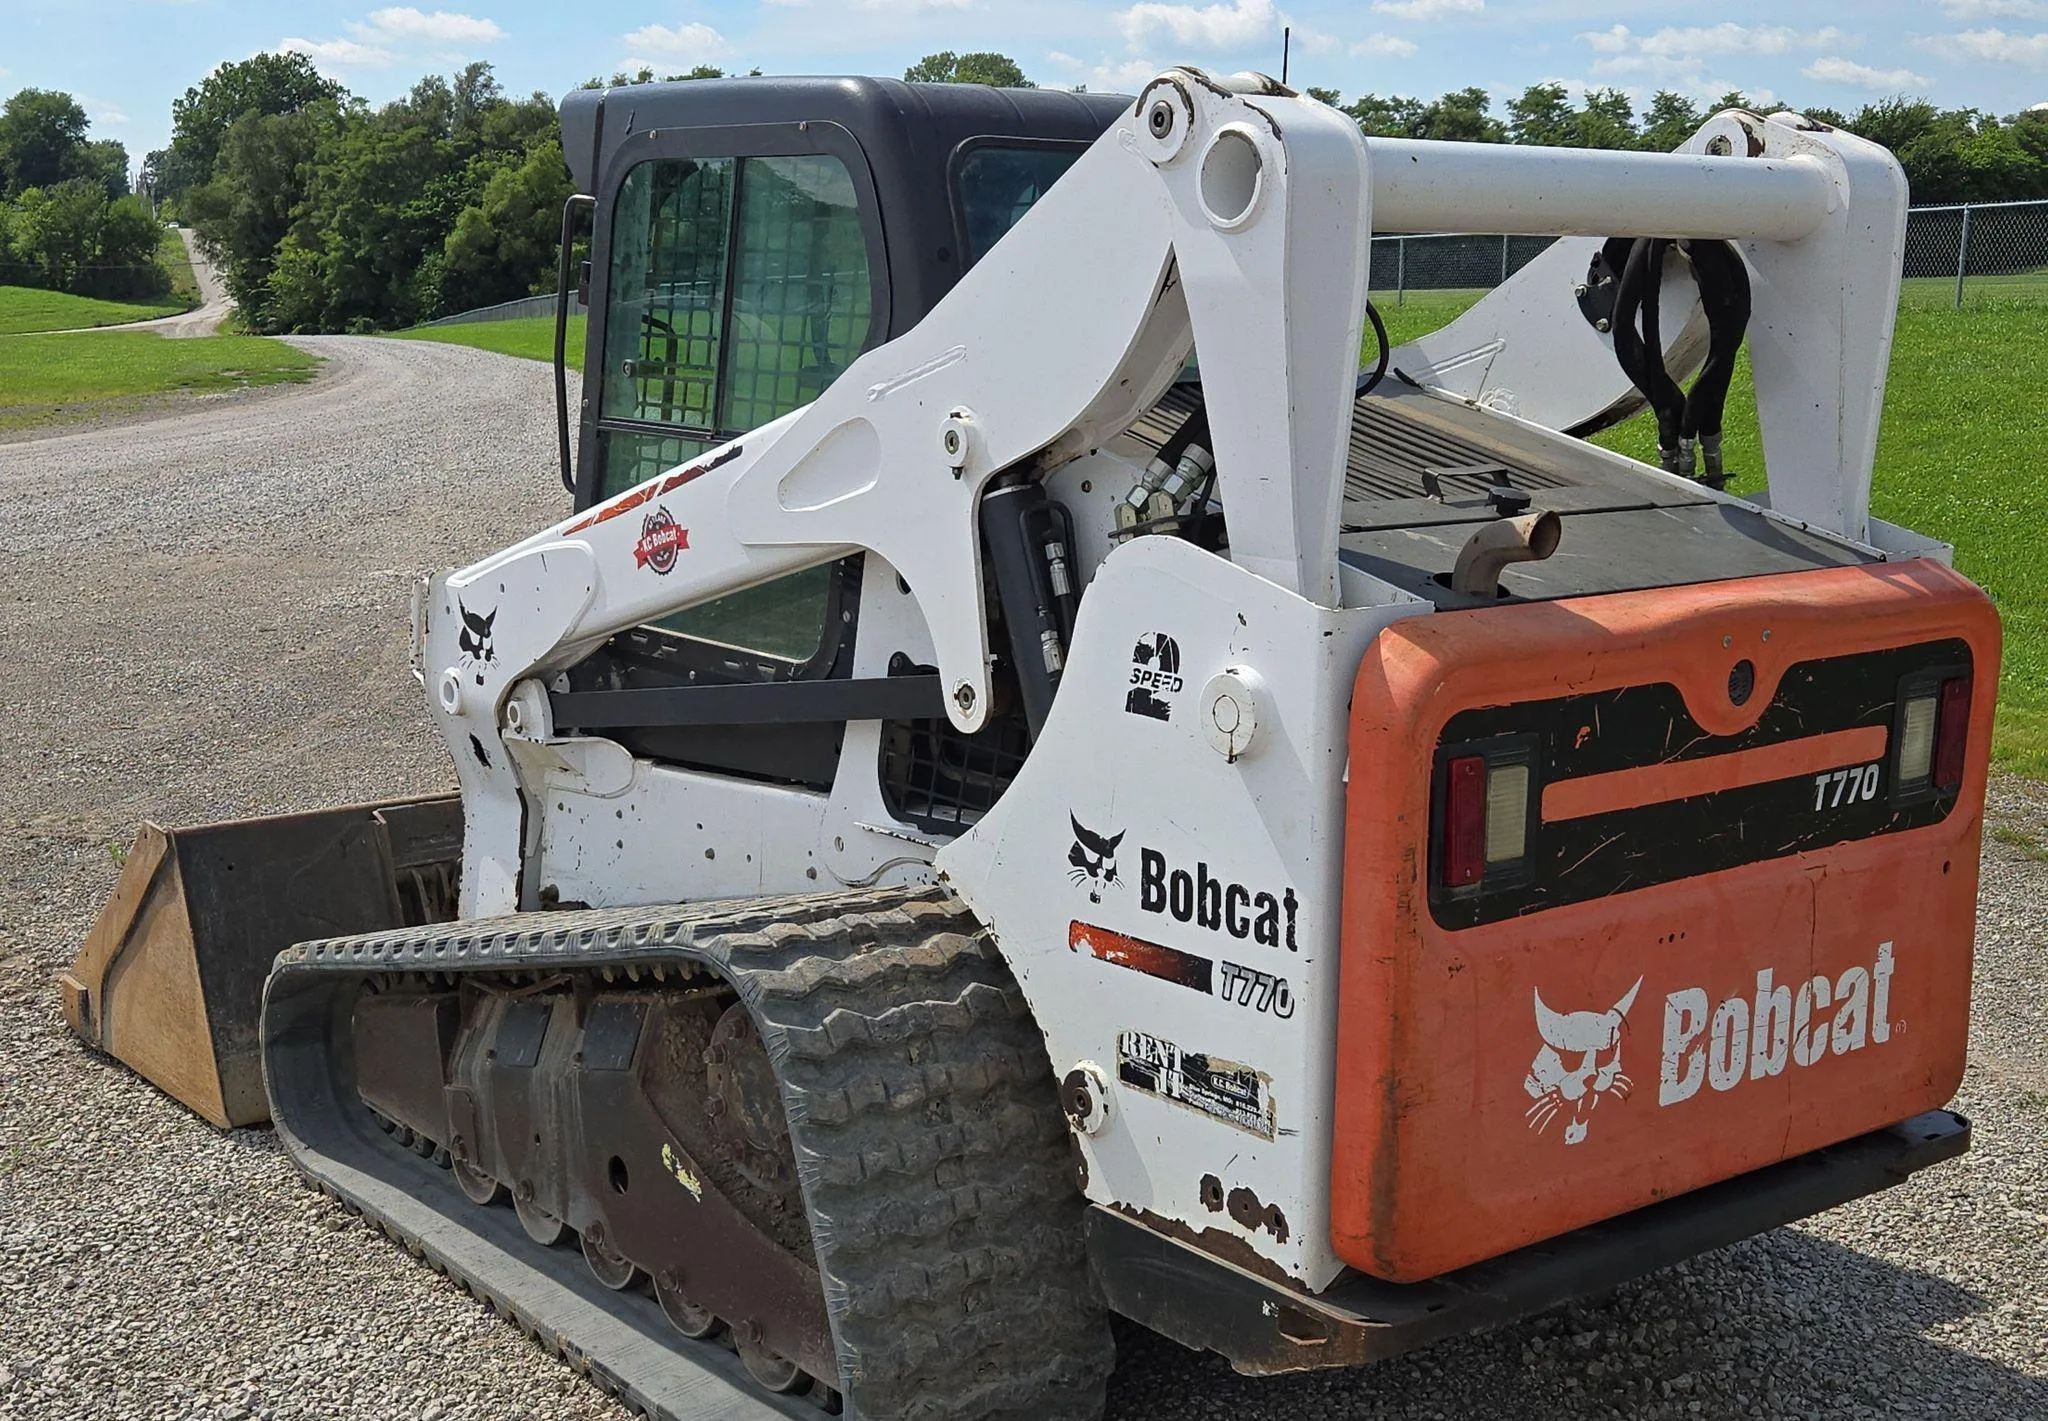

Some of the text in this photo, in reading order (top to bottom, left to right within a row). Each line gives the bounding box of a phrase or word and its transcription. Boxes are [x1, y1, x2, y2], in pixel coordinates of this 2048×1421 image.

[652, 527, 677, 546] Bobcat
[1129, 668, 1184, 693] SPEED
[1815, 764, 1880, 811] T770
[1141, 847, 1298, 952] Bobcat
[1221, 960, 1295, 1019] T770
[1659, 940, 1894, 1107] Bobcat
[1121, 1031, 1183, 1071] RENT
